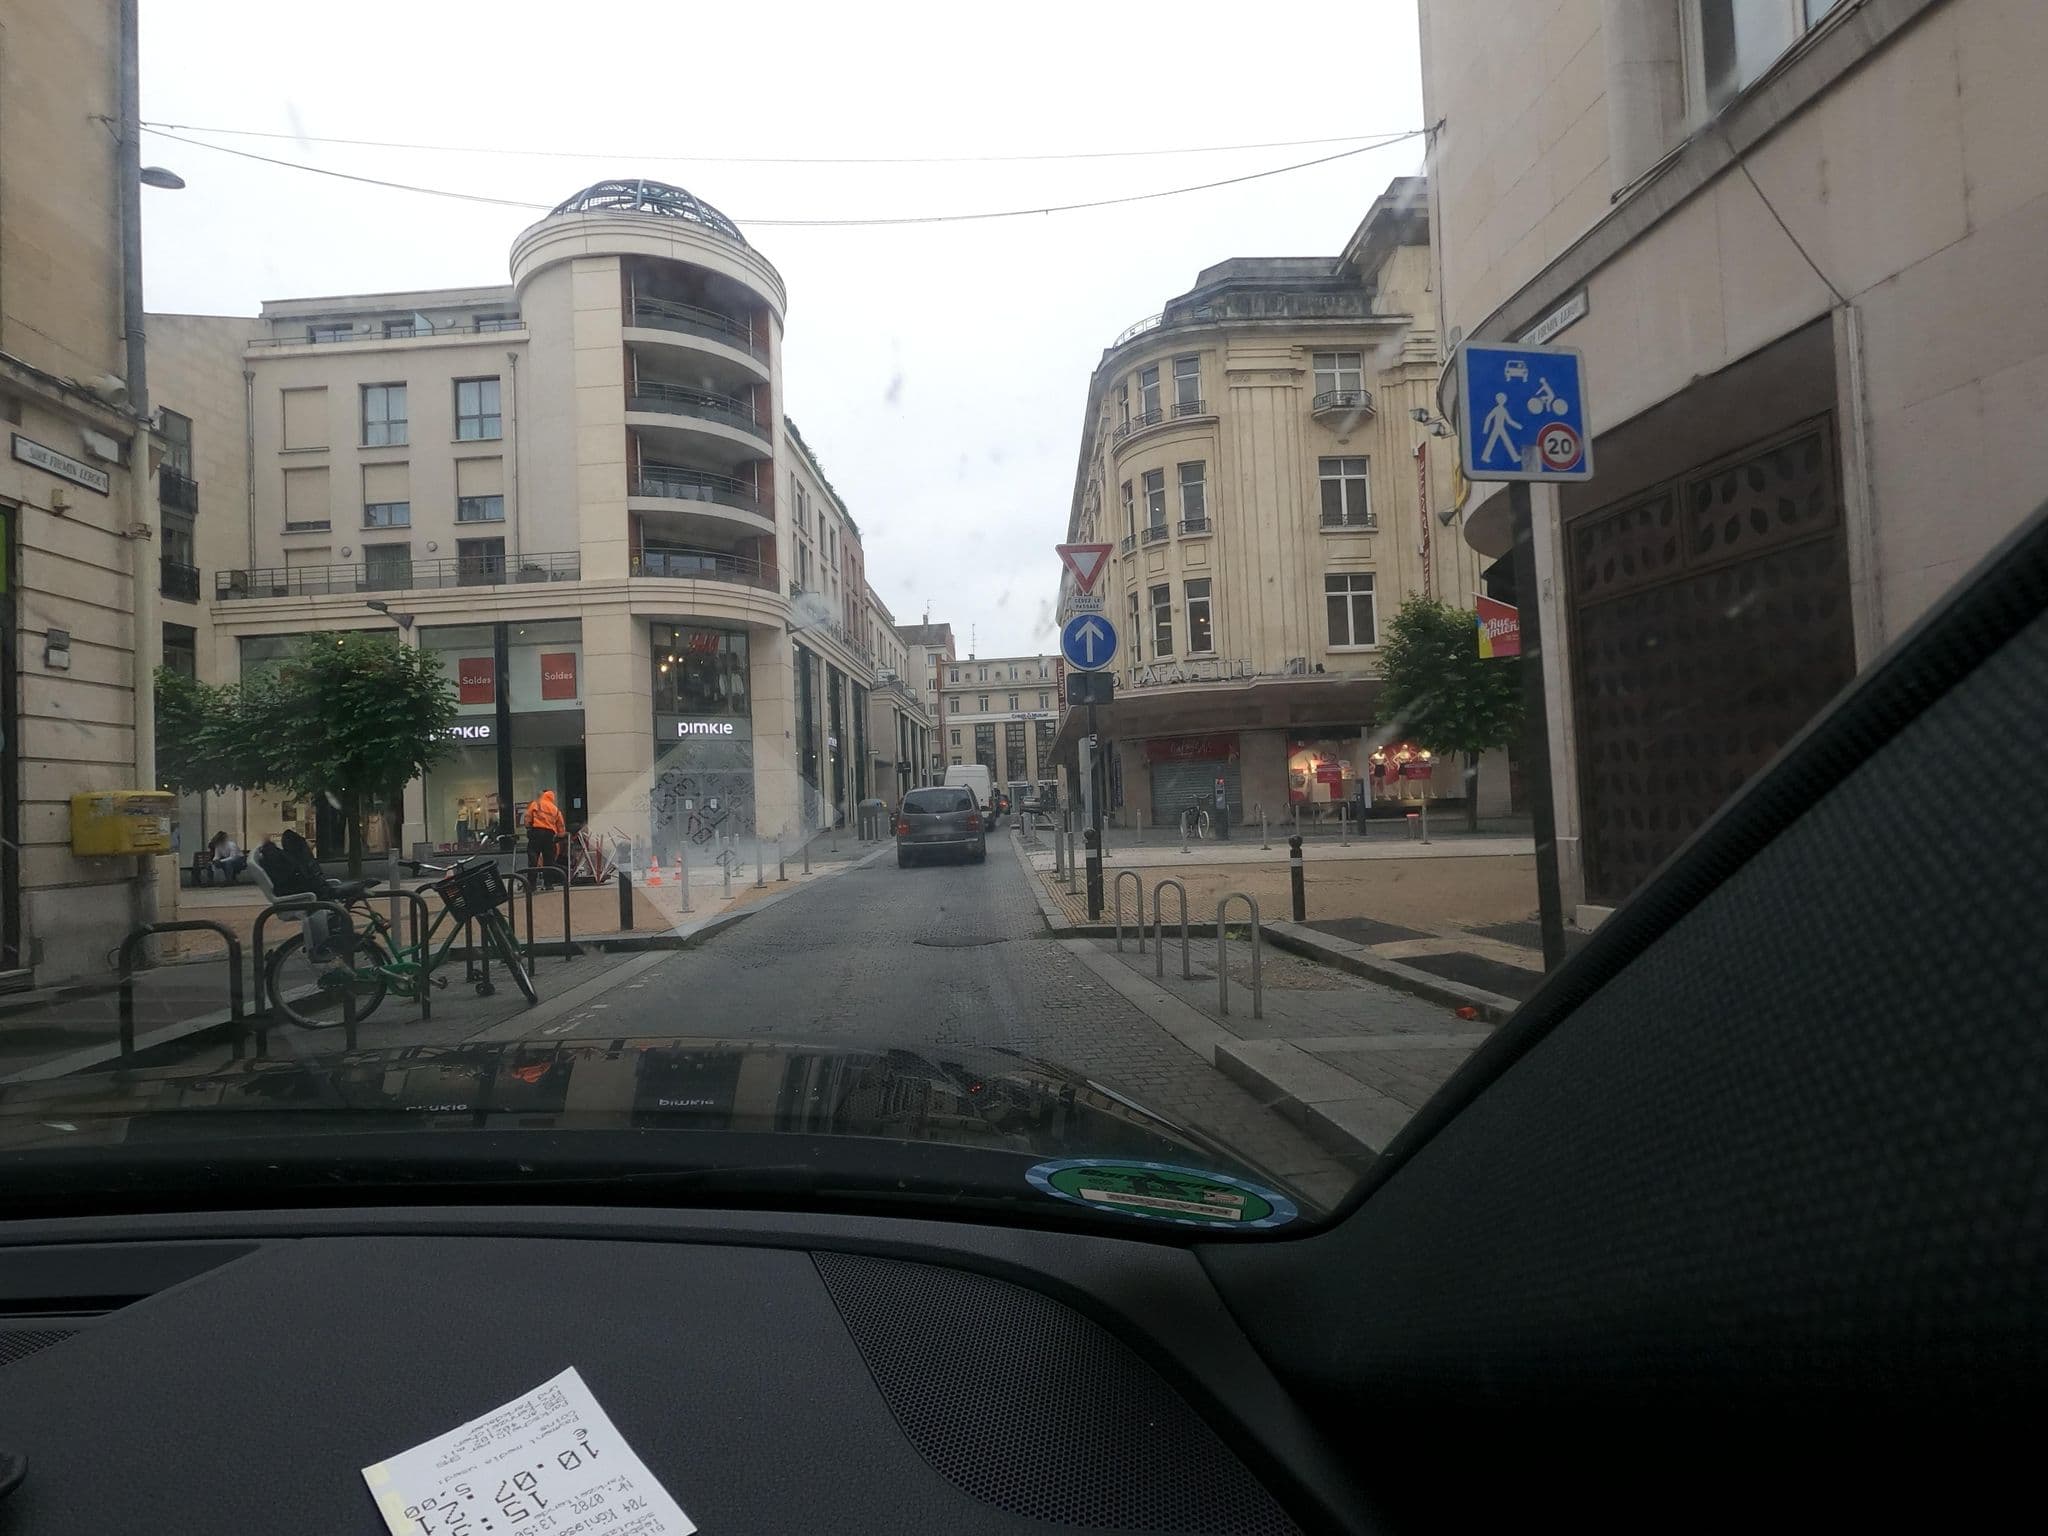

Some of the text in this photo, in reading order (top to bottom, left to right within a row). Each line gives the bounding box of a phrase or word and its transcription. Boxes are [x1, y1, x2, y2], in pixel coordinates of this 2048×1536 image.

[1547, 437, 1573, 455] 20
[462, 676, 492, 685] Soldes
[544, 671, 574, 680] Soldes
[1131, 658, 1254, 688] LAFAYETTE
[428, 725, 491, 742] mkie
[677, 722, 734, 737] pimkie
[569, 1493, 606, 1516] 0782
